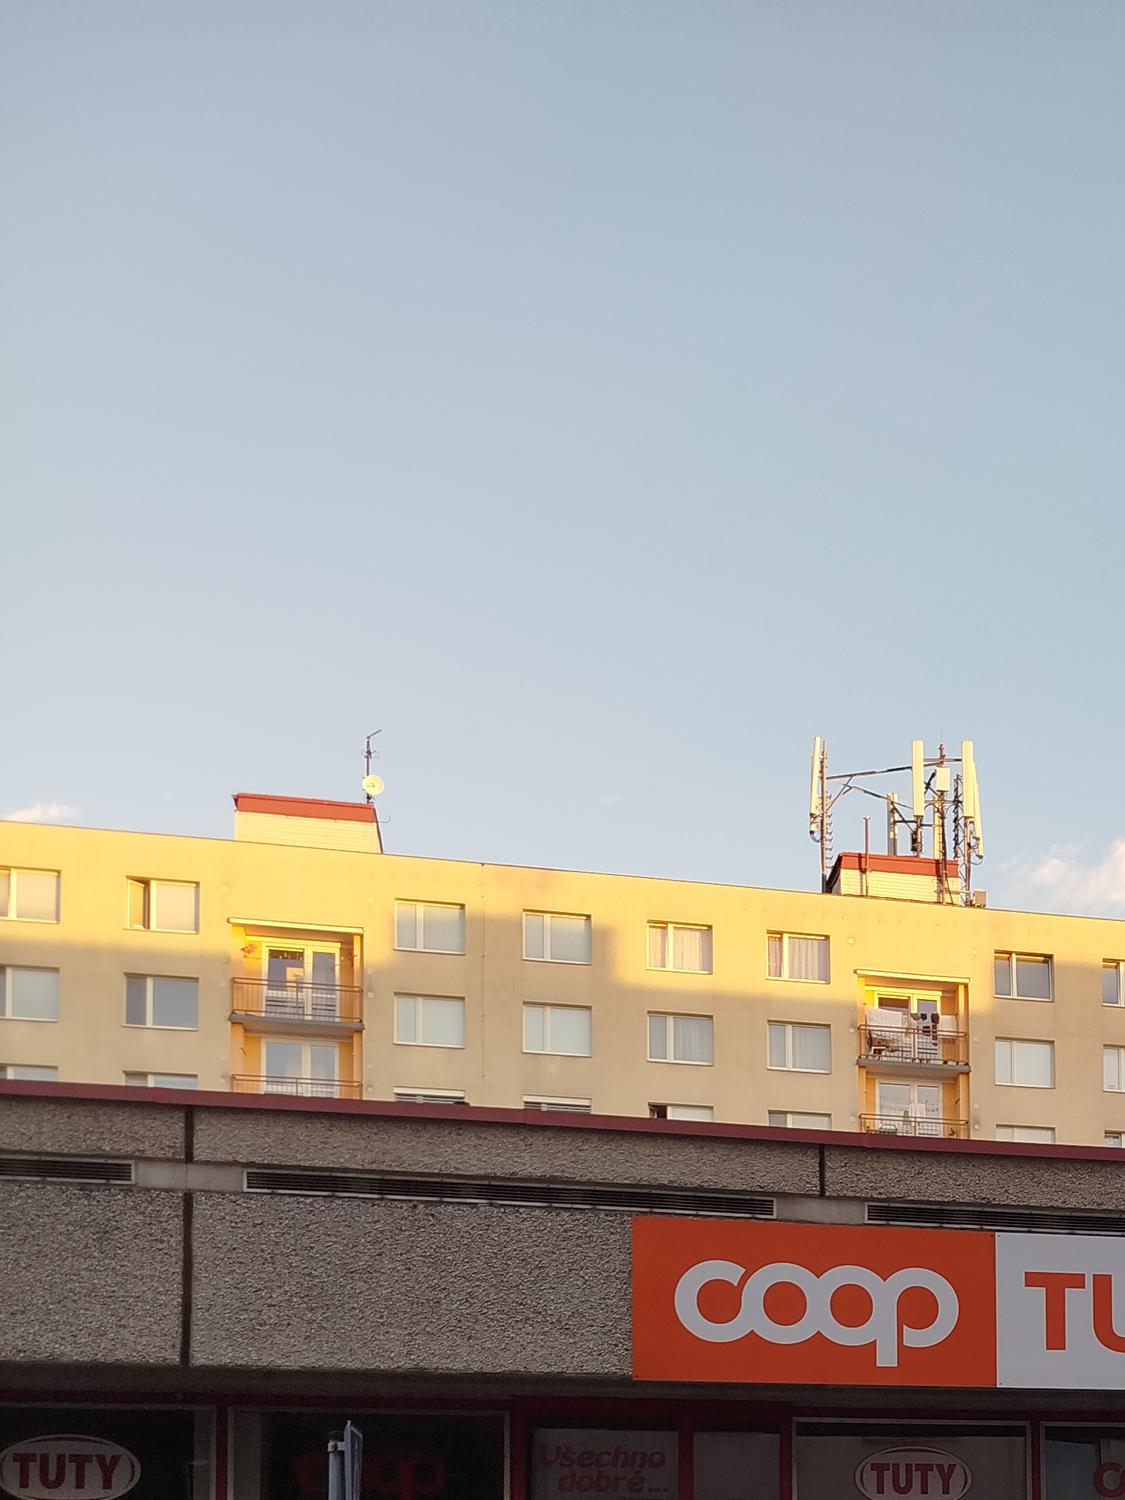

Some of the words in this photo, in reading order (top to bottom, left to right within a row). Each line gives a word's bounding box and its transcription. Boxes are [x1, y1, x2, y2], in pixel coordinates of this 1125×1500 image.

[674, 1259, 960, 1368] coop
[12, 1452, 122, 1490] TUTY
[870, 1462, 957, 1494] TUTY
